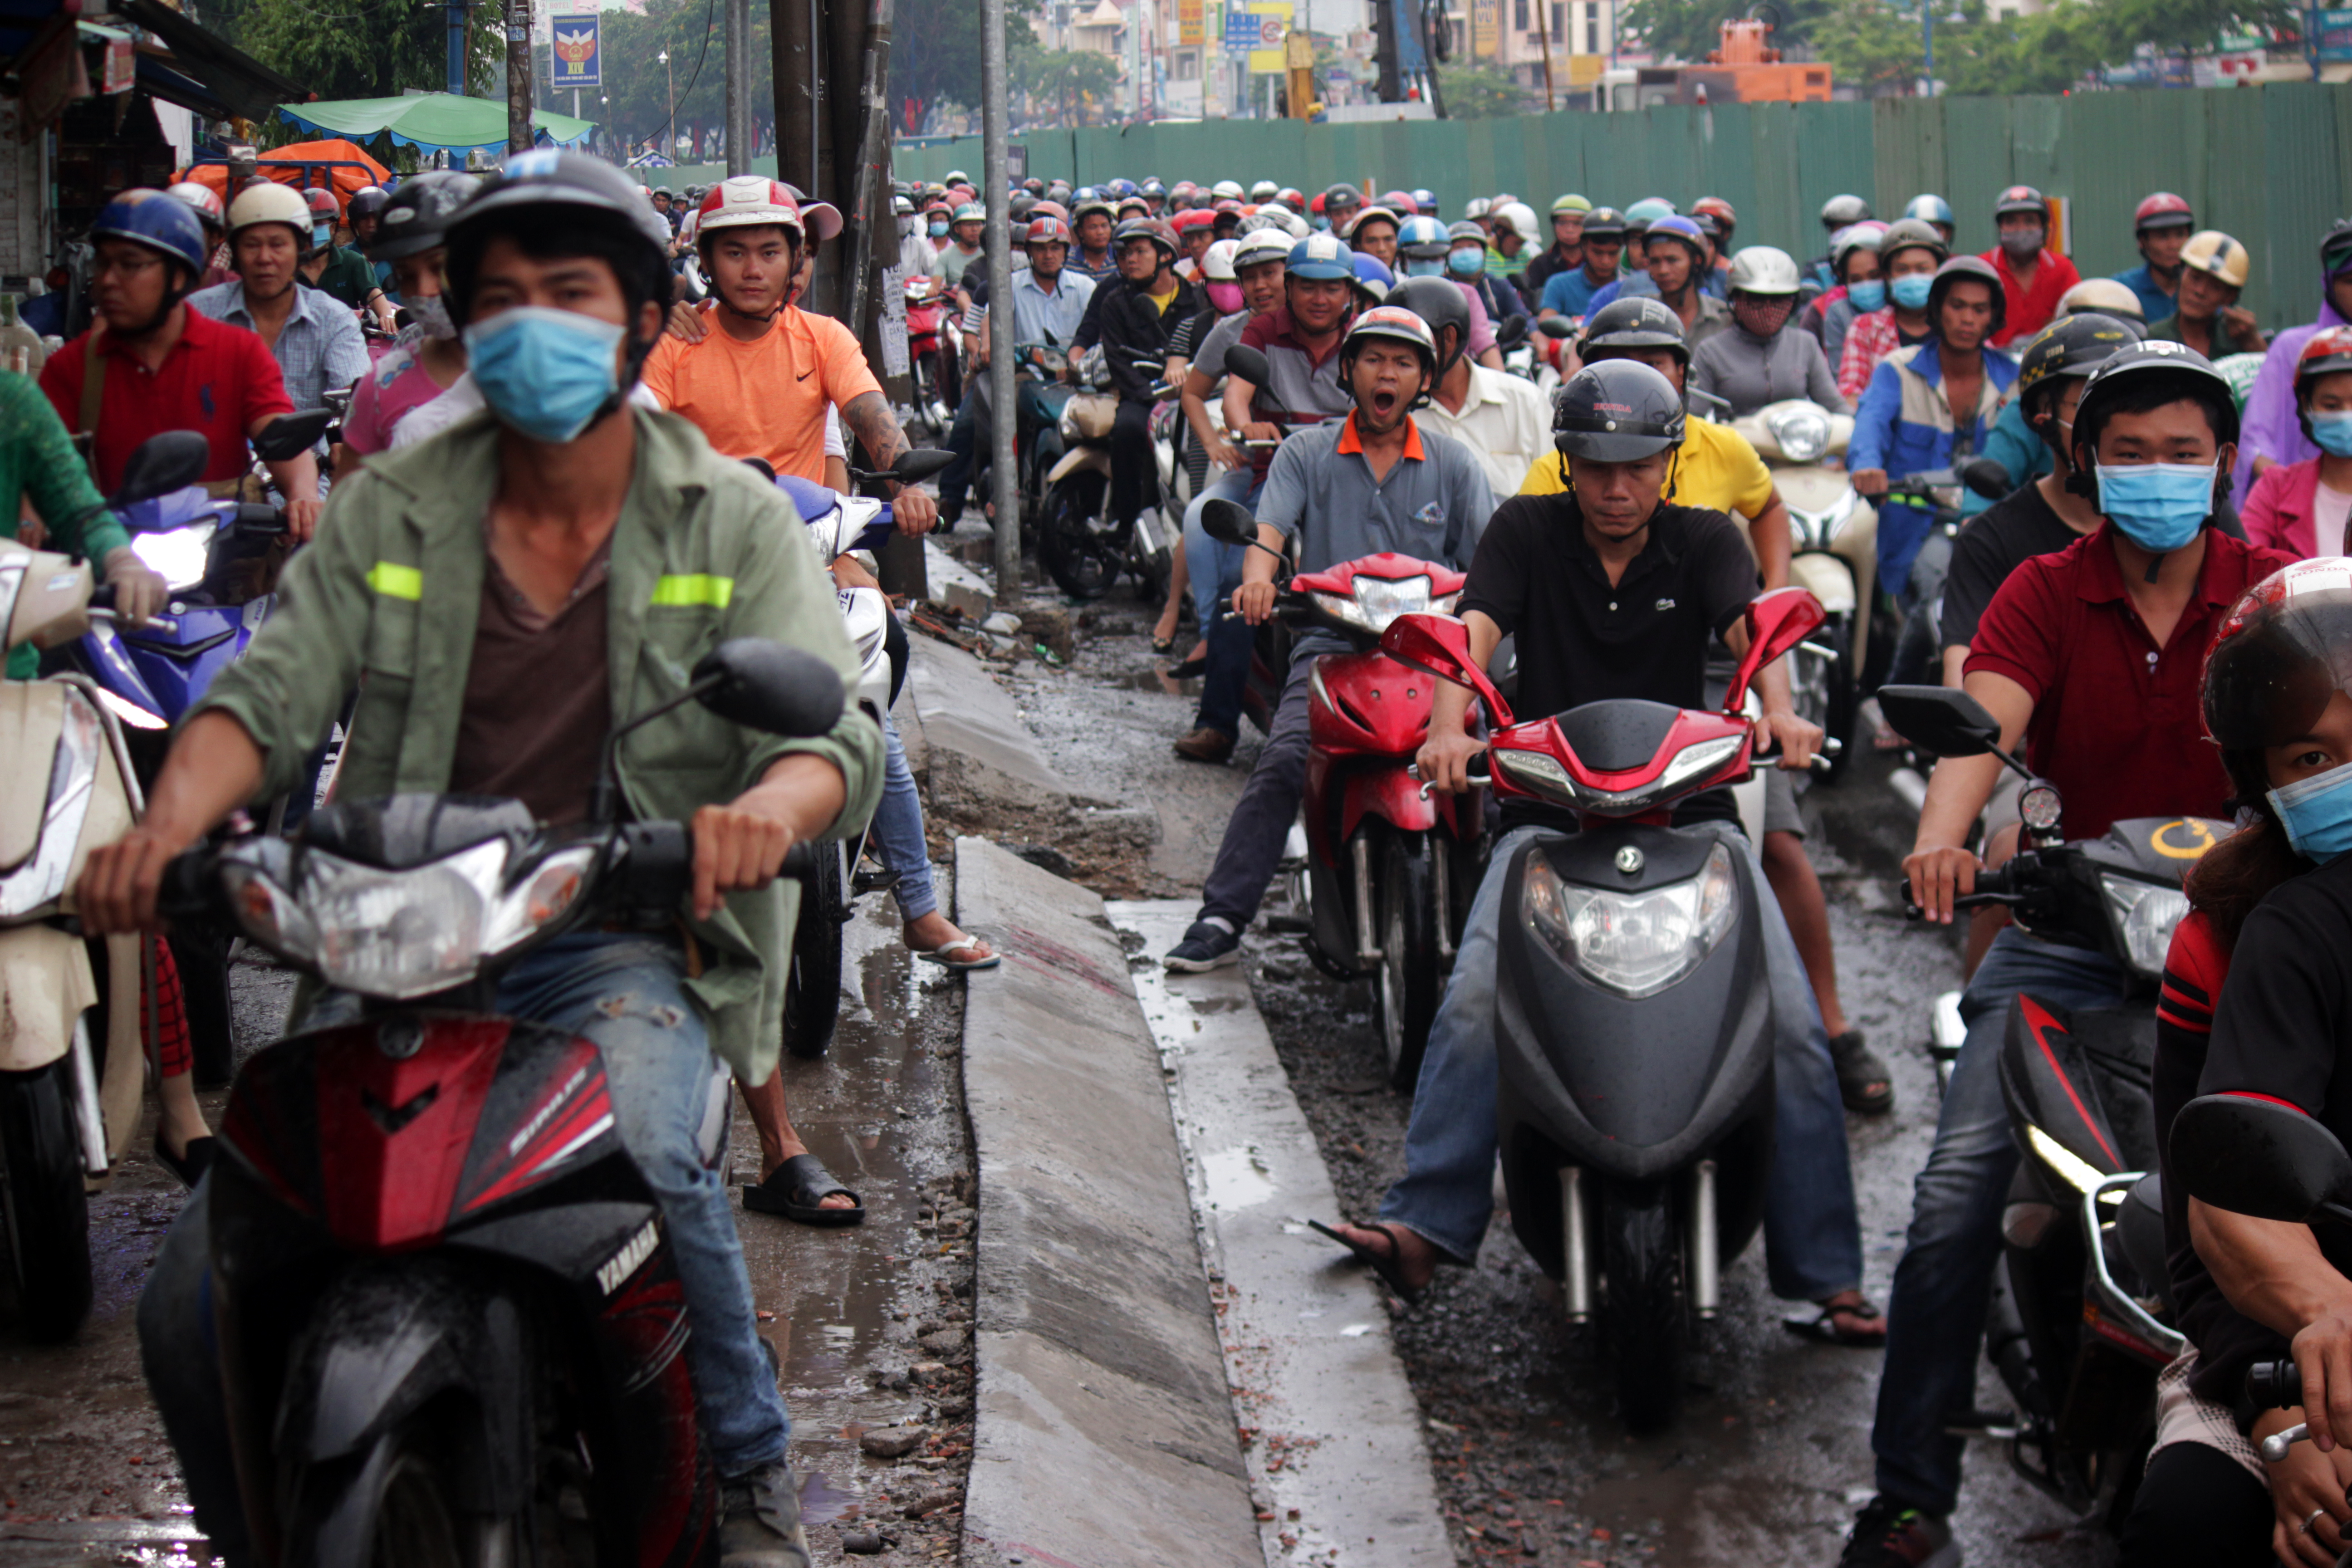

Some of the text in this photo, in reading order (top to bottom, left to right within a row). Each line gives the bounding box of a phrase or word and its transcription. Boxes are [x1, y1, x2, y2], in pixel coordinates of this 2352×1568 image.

[567, 62, 585, 74] XIV
[1593, 402, 1632, 413] HONDA
[2291, 567, 2349, 579] HONDA
[596, 1220, 659, 1296] YAMAHA
